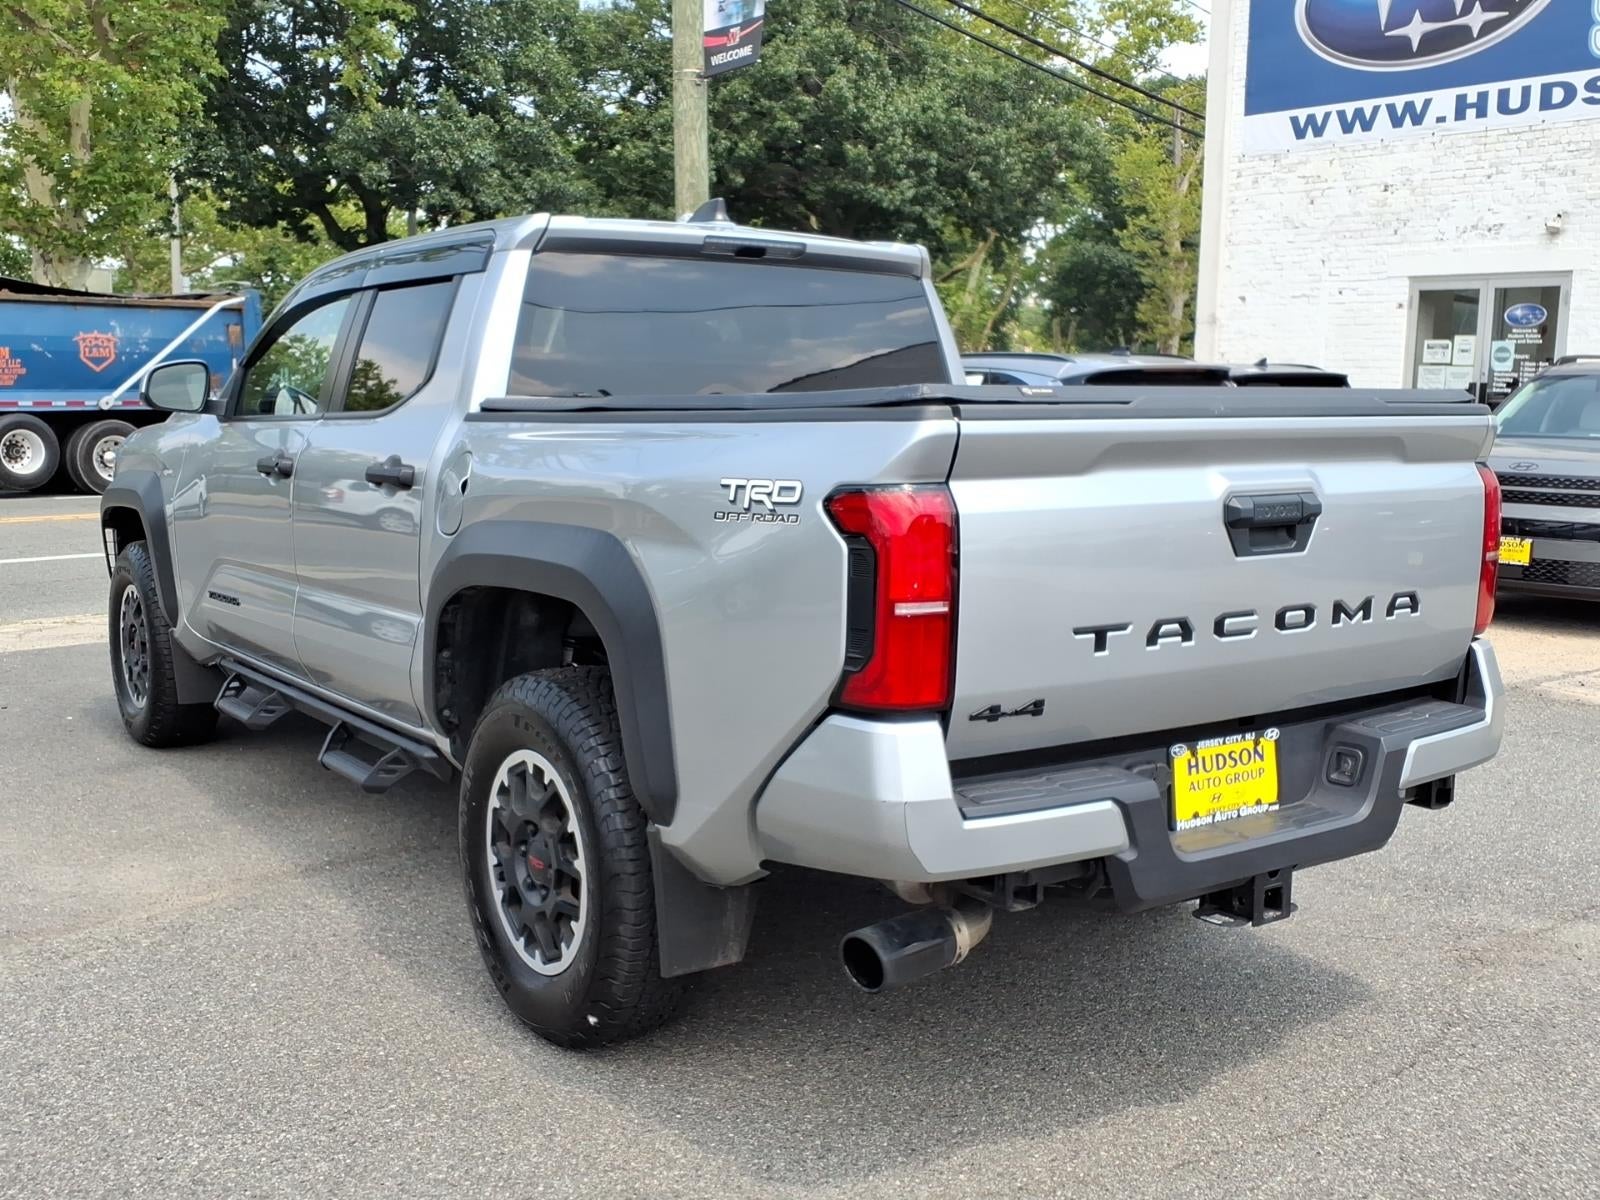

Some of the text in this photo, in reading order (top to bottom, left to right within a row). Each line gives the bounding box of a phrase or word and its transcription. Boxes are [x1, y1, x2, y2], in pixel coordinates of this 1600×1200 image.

[710, 44, 753, 66] WELCOME
[720, 478, 803, 511] TRD
[714, 511, 800, 525] OFF ROAD
[1072, 590, 1421, 656] TACOMA
[1196, 737, 1225, 749] JERSEY
[1245, 732, 1256, 741] NJ
[1187, 744, 1264, 776] HUDSON
[1189, 768, 1265, 792] AUTO GROUP
